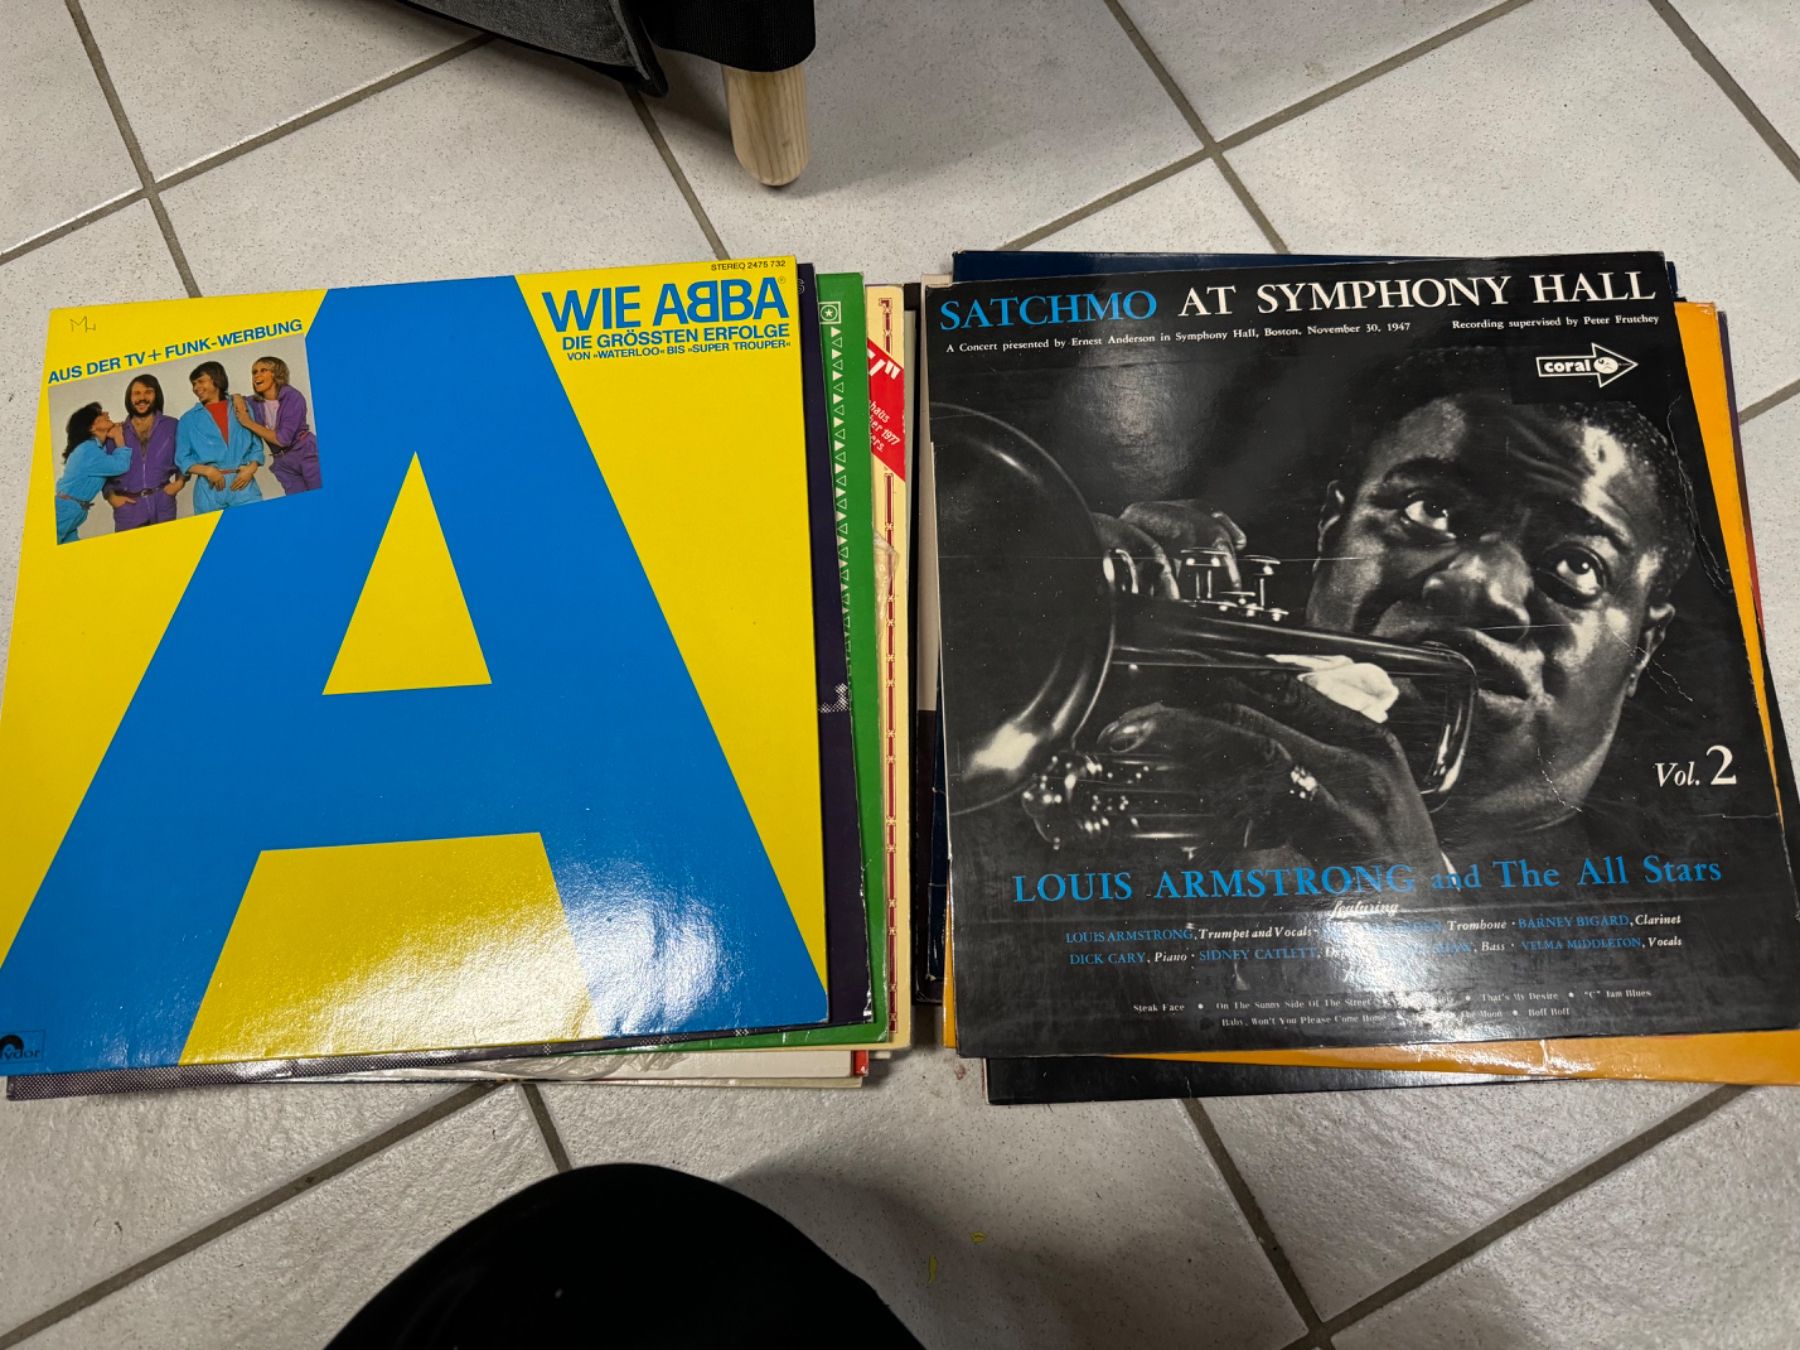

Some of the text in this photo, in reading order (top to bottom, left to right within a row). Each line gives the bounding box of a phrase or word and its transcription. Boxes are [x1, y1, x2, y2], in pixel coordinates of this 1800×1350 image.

[711, 259, 786, 272] STEREO 2475 732
[541, 277, 789, 332] WIE ABBA
[939, 271, 1657, 331] SATCHMO AT SYMPHONY HALL
[1452, 314, 1660, 330] Recording supervised by Peter Frutchey
[562, 323, 790, 351] DIE GRÖSSTEN ERFOLGE
[946, 344, 955, 353] A
[959, 342, 998, 352] Concert
[1002, 338, 1050, 352] presented
[1054, 338, 1066, 348] by
[1071, 337, 1103, 347] Ernest
[1107, 334, 1155, 345] Anderson
[1160, 333, 1171, 342] in
[1175, 329, 1228, 343] Symphony
[1233, 327, 1259, 338] Hall,
[1307, 323, 1361, 335] November
[1387, 322, 1411, 332] 1947
[48, 318, 303, 384] AUS DER TV + FUNK-WERBUNG
[567, 351, 591, 361] VON
[666, 345, 685, 355] BIS
[1543, 359, 1592, 374] coral
[1654, 744, 1738, 788] Vol. 2
[1012, 854, 1722, 903] LOUIS ARMSTRONG and The All Stars
[1329, 900, 1399, 919] featuring
[1447, 919, 1507, 931] Trombone
[1518, 916, 1573, 929] BARNEY
[1634, 914, 1682, 926] Clarinet
[1066, 931, 1105, 944] LOUIS
[1198, 928, 1250, 942] Trumpet
[1251, 926, 1273, 938] and
[1274, 925, 1312, 938] Vocals
[1481, 941, 1506, 952] Bass
[1520, 939, 1563, 951] VELMA
[1647, 936, 1683, 947] Vocals
[1069, 953, 1103, 965] DICK
[1154, 951, 1188, 963] Piano
[1199, 949, 1250, 961] SIDNEY
[1625, 989, 1652, 998] Blues
[1133, 1003, 1185, 1012] Steak Face
[1216, 1002, 1229, 1010] On
[1234, 1001, 1250, 1010] The
[1284, 1000, 1304, 1009] Side
[1324, 999, 1341, 1007] The
[1345, 999, 1371, 1007] Street
[1279, 1017, 1297, 1026] You
[1300, 1016, 1332, 1025] Please
[1334, 1015, 1358, 1023] Come
